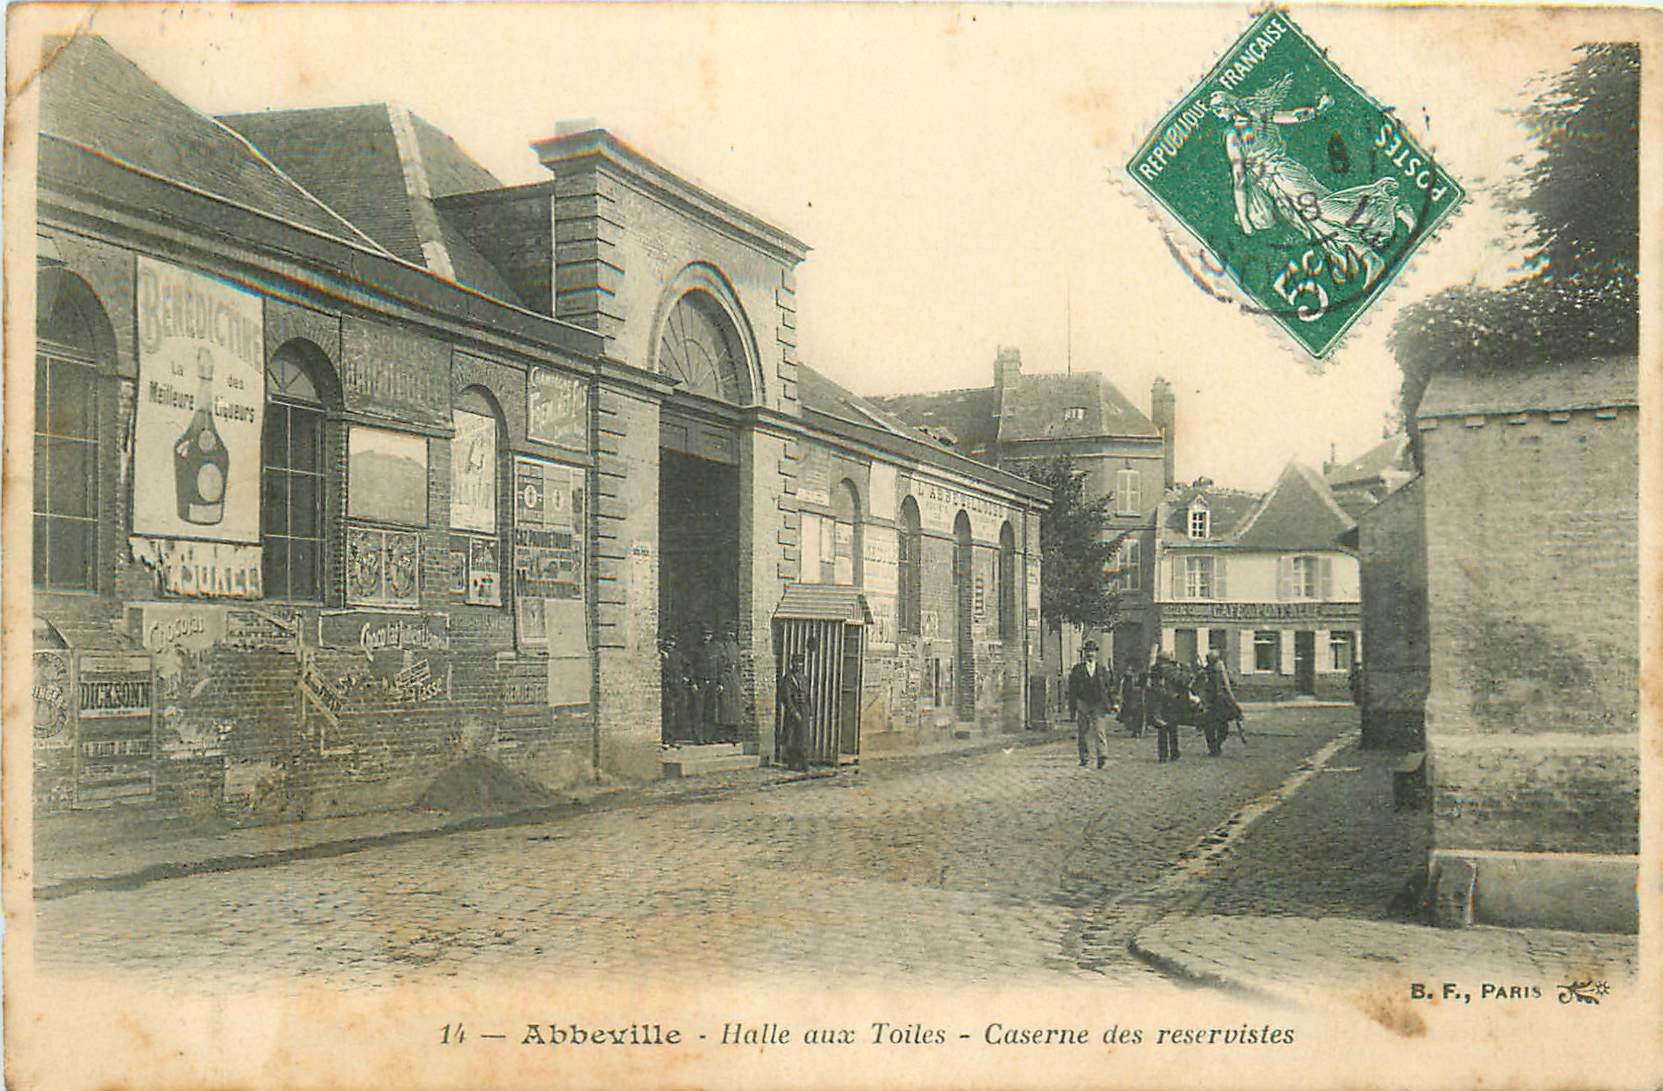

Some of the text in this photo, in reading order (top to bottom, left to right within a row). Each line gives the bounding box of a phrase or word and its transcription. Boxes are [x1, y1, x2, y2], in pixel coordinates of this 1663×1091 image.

[1219, 18, 1287, 90] FRANÇAISE
[1375, 122, 1448, 202] POSTES
[228, 373, 245, 391] des
[214, 394, 256, 425] Liqueurs
